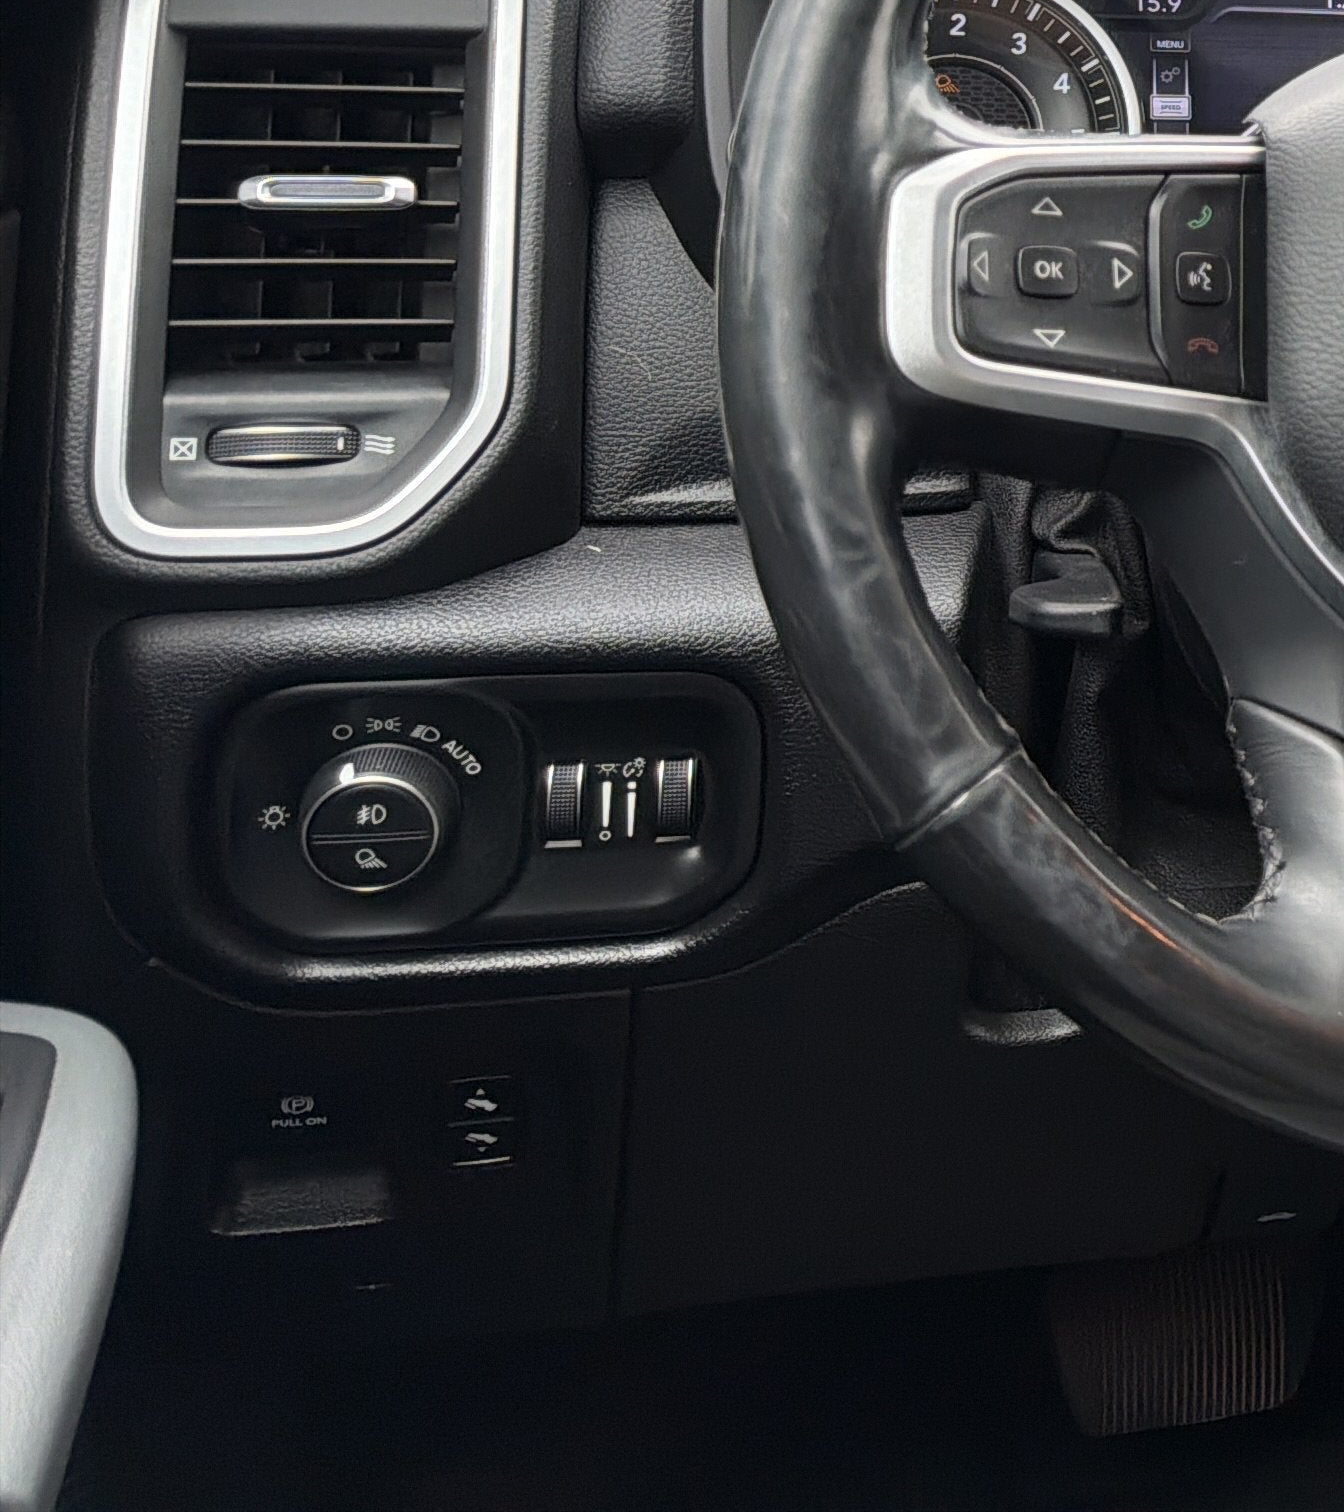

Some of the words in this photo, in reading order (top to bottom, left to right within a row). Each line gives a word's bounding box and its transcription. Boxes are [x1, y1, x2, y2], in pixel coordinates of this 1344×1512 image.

[950, 13, 967, 36] 2
[1010, 32, 1027, 55] 3
[1156, 39, 1185, 49] MENU
[1053, 72, 1071, 94] 4
[1033, 260, 1064, 279] OK
[441, 739, 482, 777] AUTO
[271, 1116, 301, 1128] PULL
[304, 1115, 327, 1126] ON
